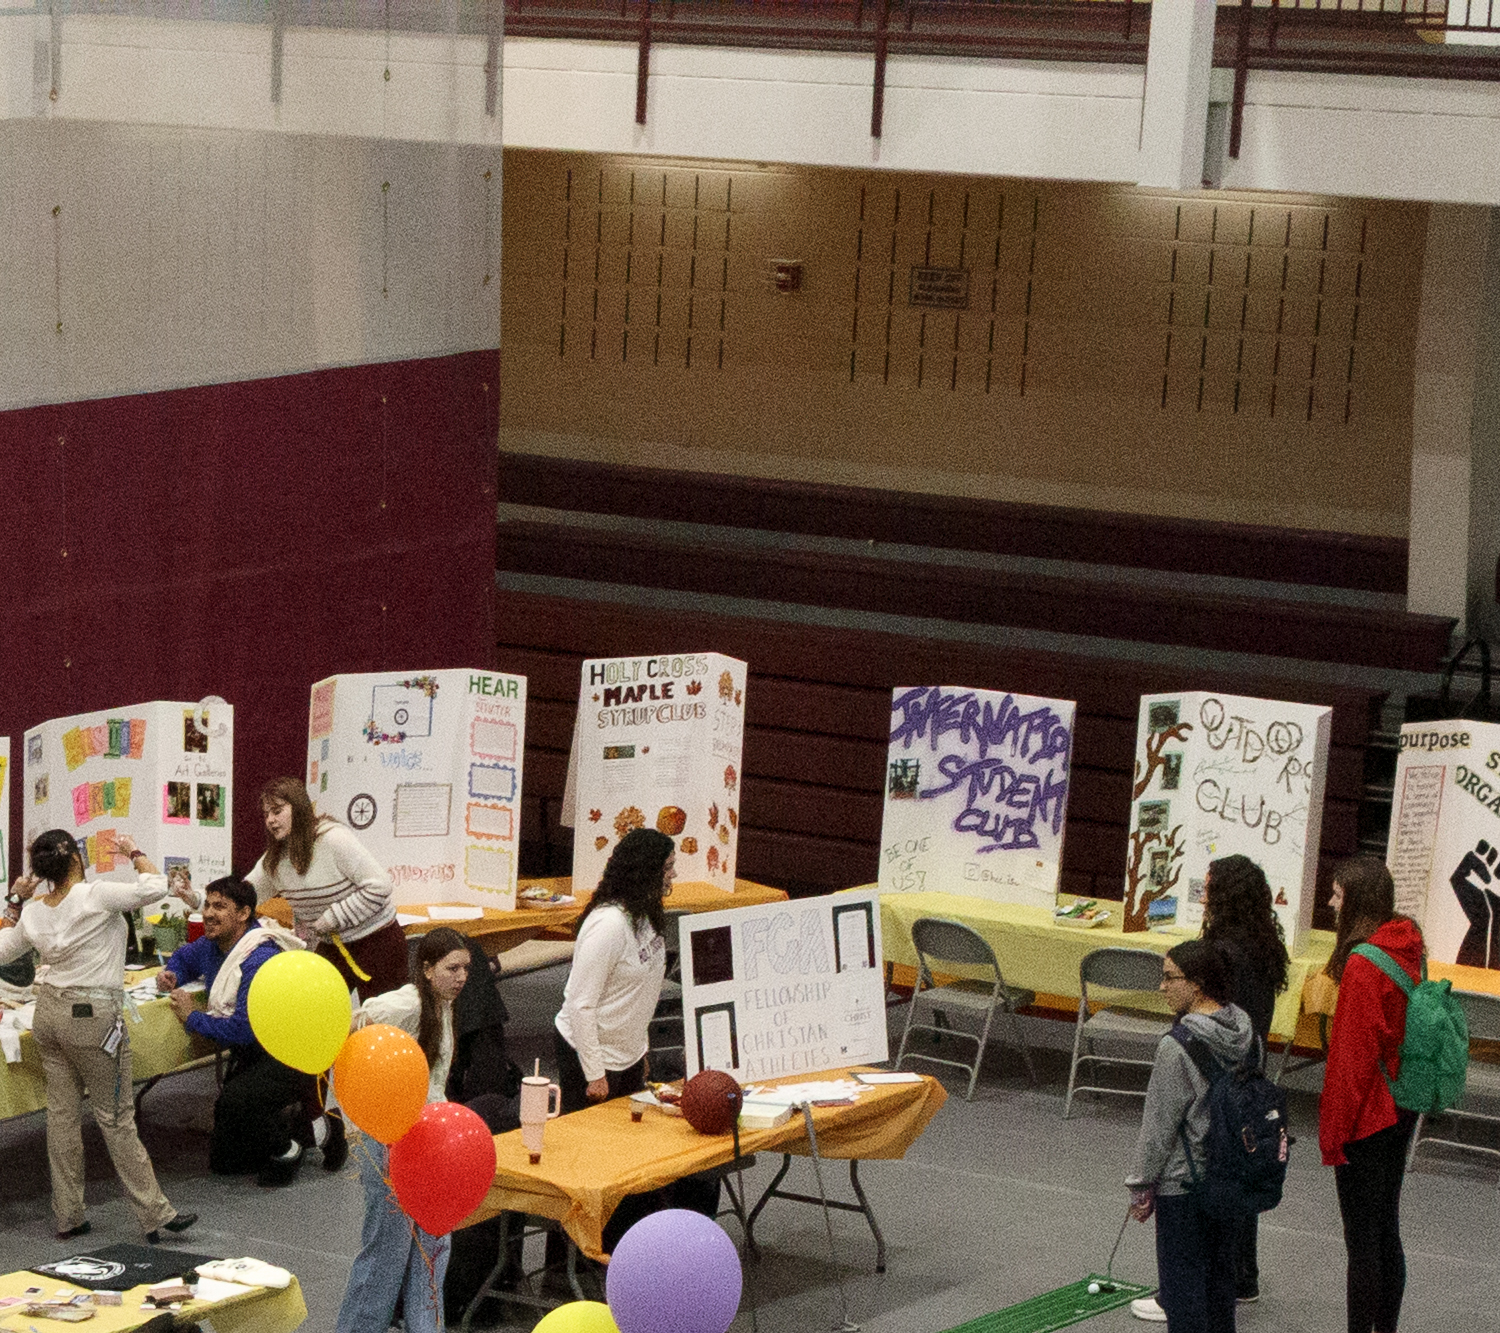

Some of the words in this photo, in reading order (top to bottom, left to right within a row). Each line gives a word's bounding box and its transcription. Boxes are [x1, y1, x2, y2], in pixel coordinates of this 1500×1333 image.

[590, 661, 641, 686] HOLY
[647, 654, 708, 679] CROSS
[468, 675, 519, 699] HEAR
[603, 681, 675, 707] MAPLE
[598, 704, 656, 729] SYRUP
[656, 702, 707, 724] CLUB
[1399, 730, 1472, 751] purpose
[919, 754, 1067, 836] STUDENT
[1196, 778, 1283, 845] CLUB
[953, 807, 1041, 855] CLUB
[741, 908, 830, 981] FCA
[744, 982, 831, 1011] FELLOWSHIP
[773, 1010, 789, 1028] OF
[745, 1046, 830, 1080] ATHLETES
